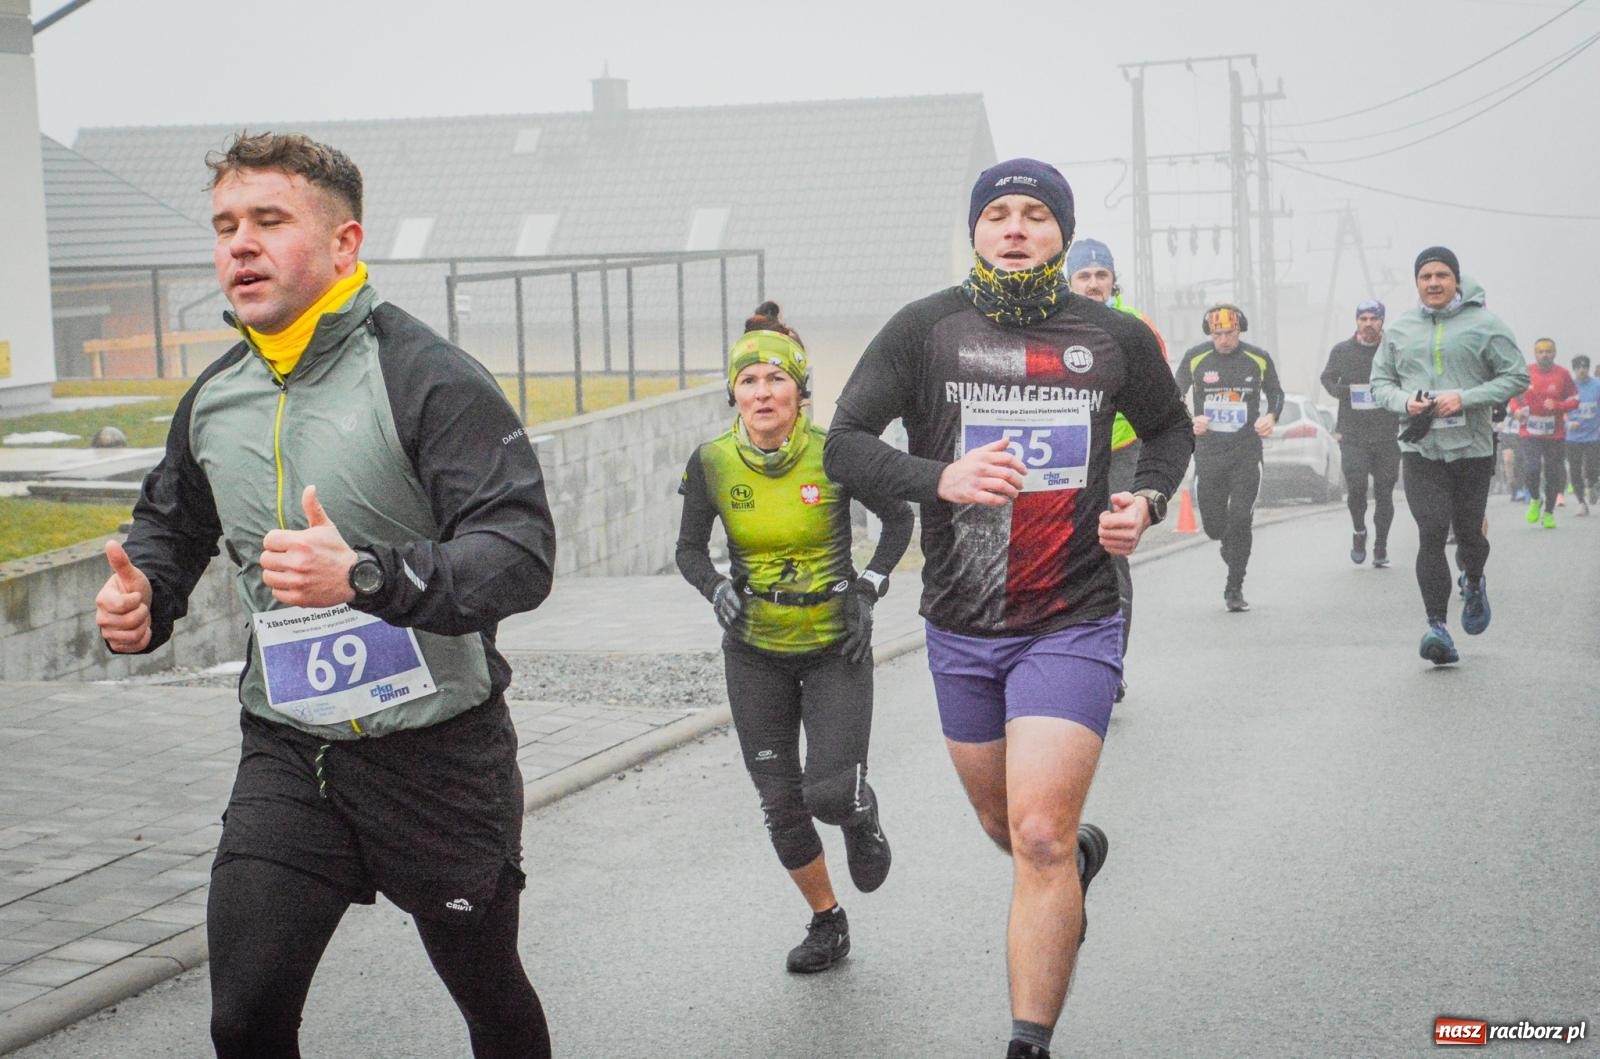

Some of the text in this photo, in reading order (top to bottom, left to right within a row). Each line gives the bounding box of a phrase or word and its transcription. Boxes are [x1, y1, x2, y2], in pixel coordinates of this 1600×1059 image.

[1012, 175, 1038, 184] SPORT
[945, 381, 1104, 412] RUNMAGEDDON
[1001, 429, 1053, 467] 55
[272, 620, 284, 628] Eko
[283, 617, 302, 626] Cross
[302, 615, 311, 624] po
[310, 610, 332, 621] Ziemi
[307, 634, 368, 692] 69
